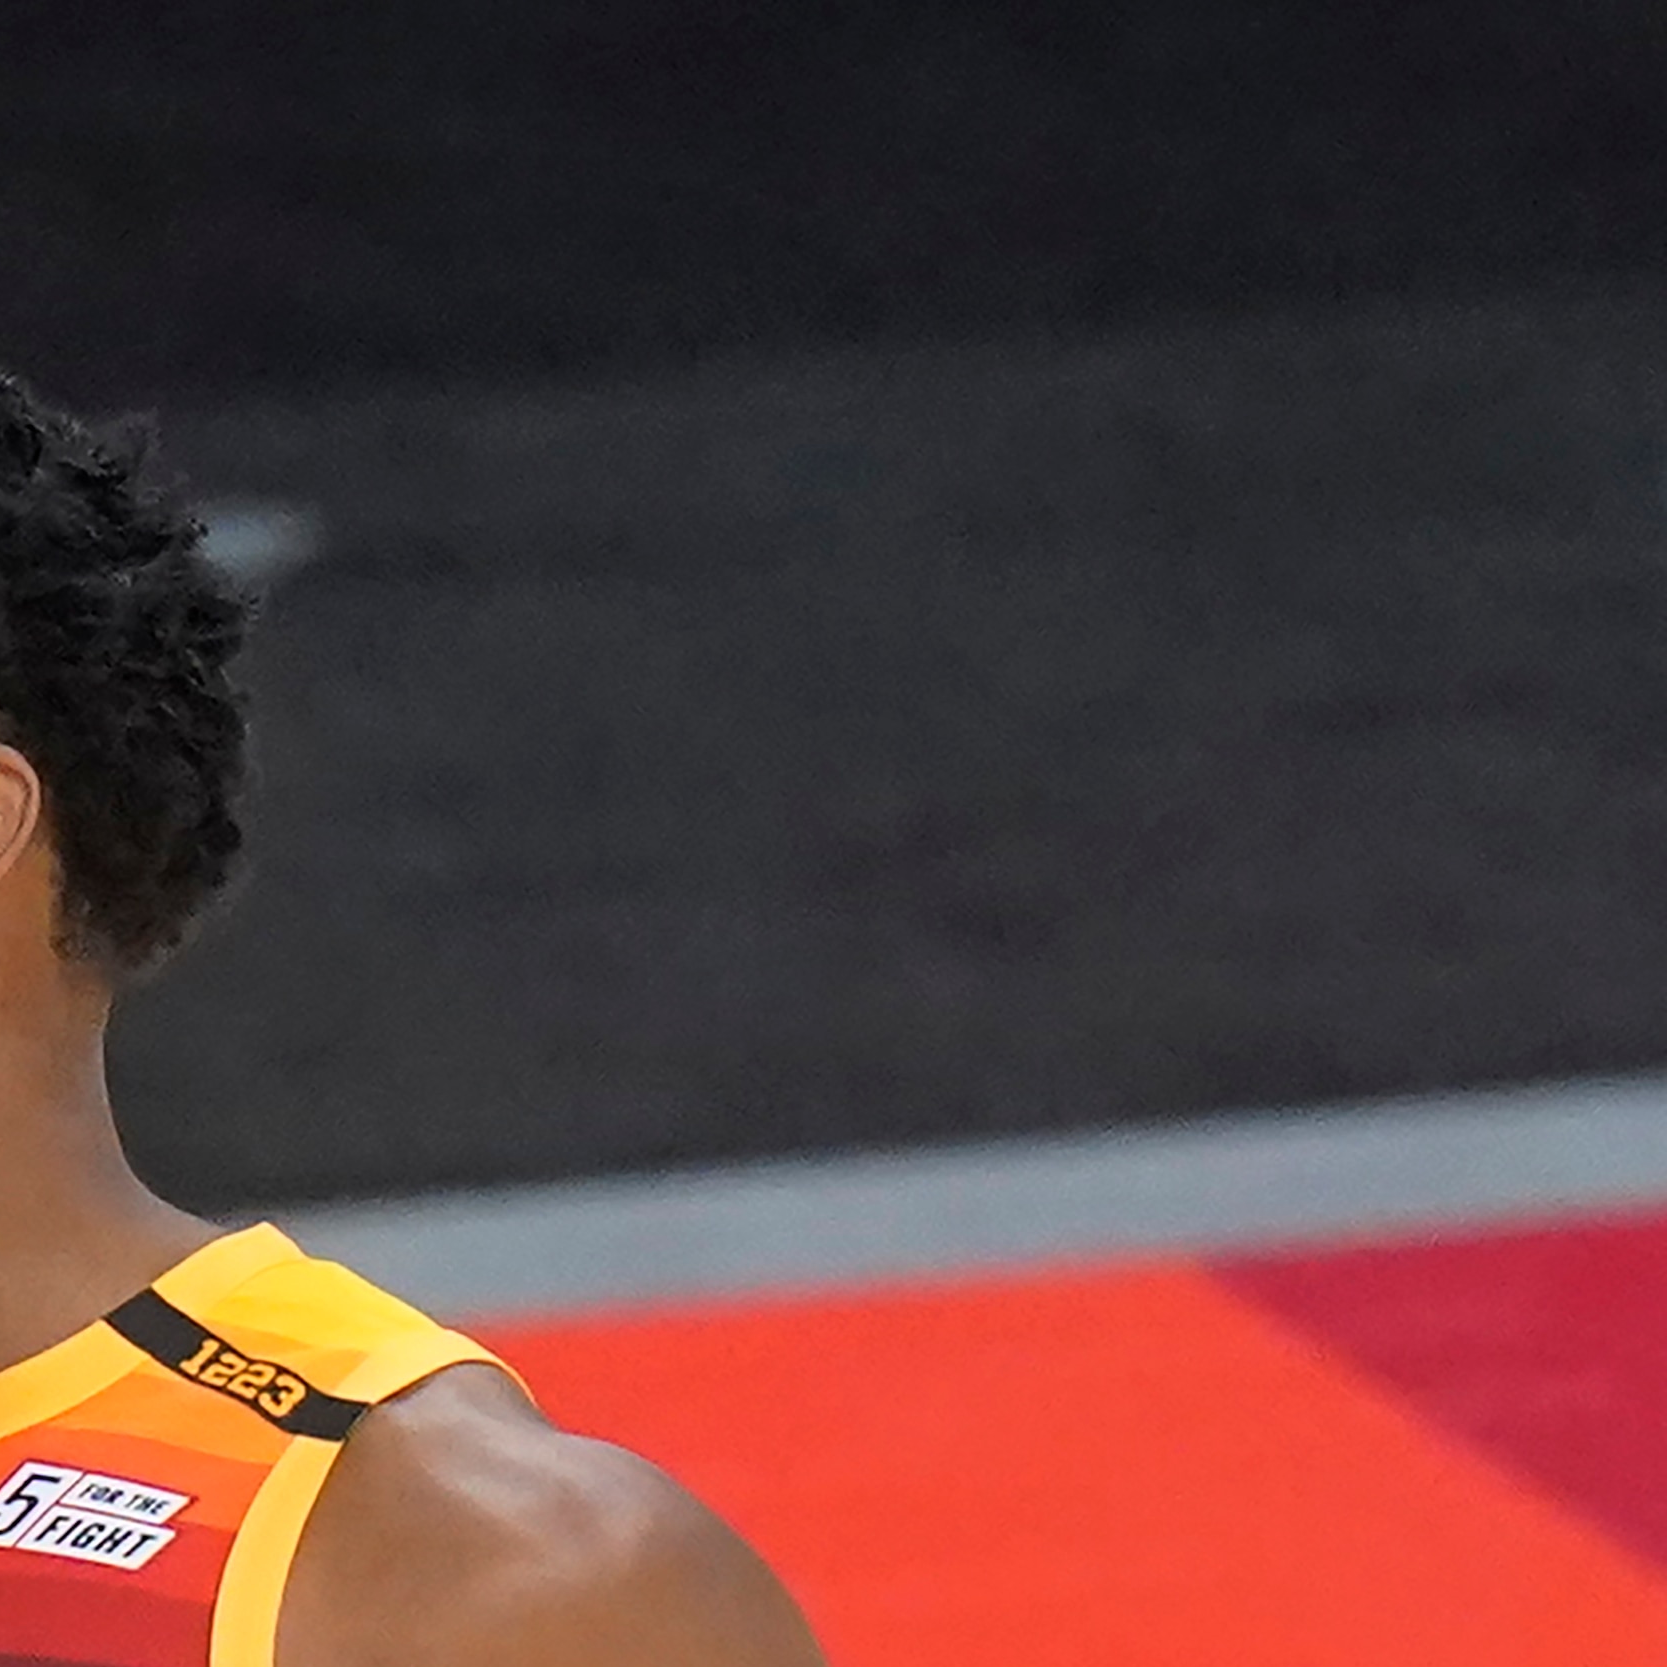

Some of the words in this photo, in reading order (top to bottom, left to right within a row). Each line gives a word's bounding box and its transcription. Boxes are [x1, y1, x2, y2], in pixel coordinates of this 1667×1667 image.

[178, 1338, 307, 1418] 1223
[78, 1483, 124, 1505] FOR
[124, 1494, 171, 1516] THE
[34, 1514, 157, 1559] FIGHT
